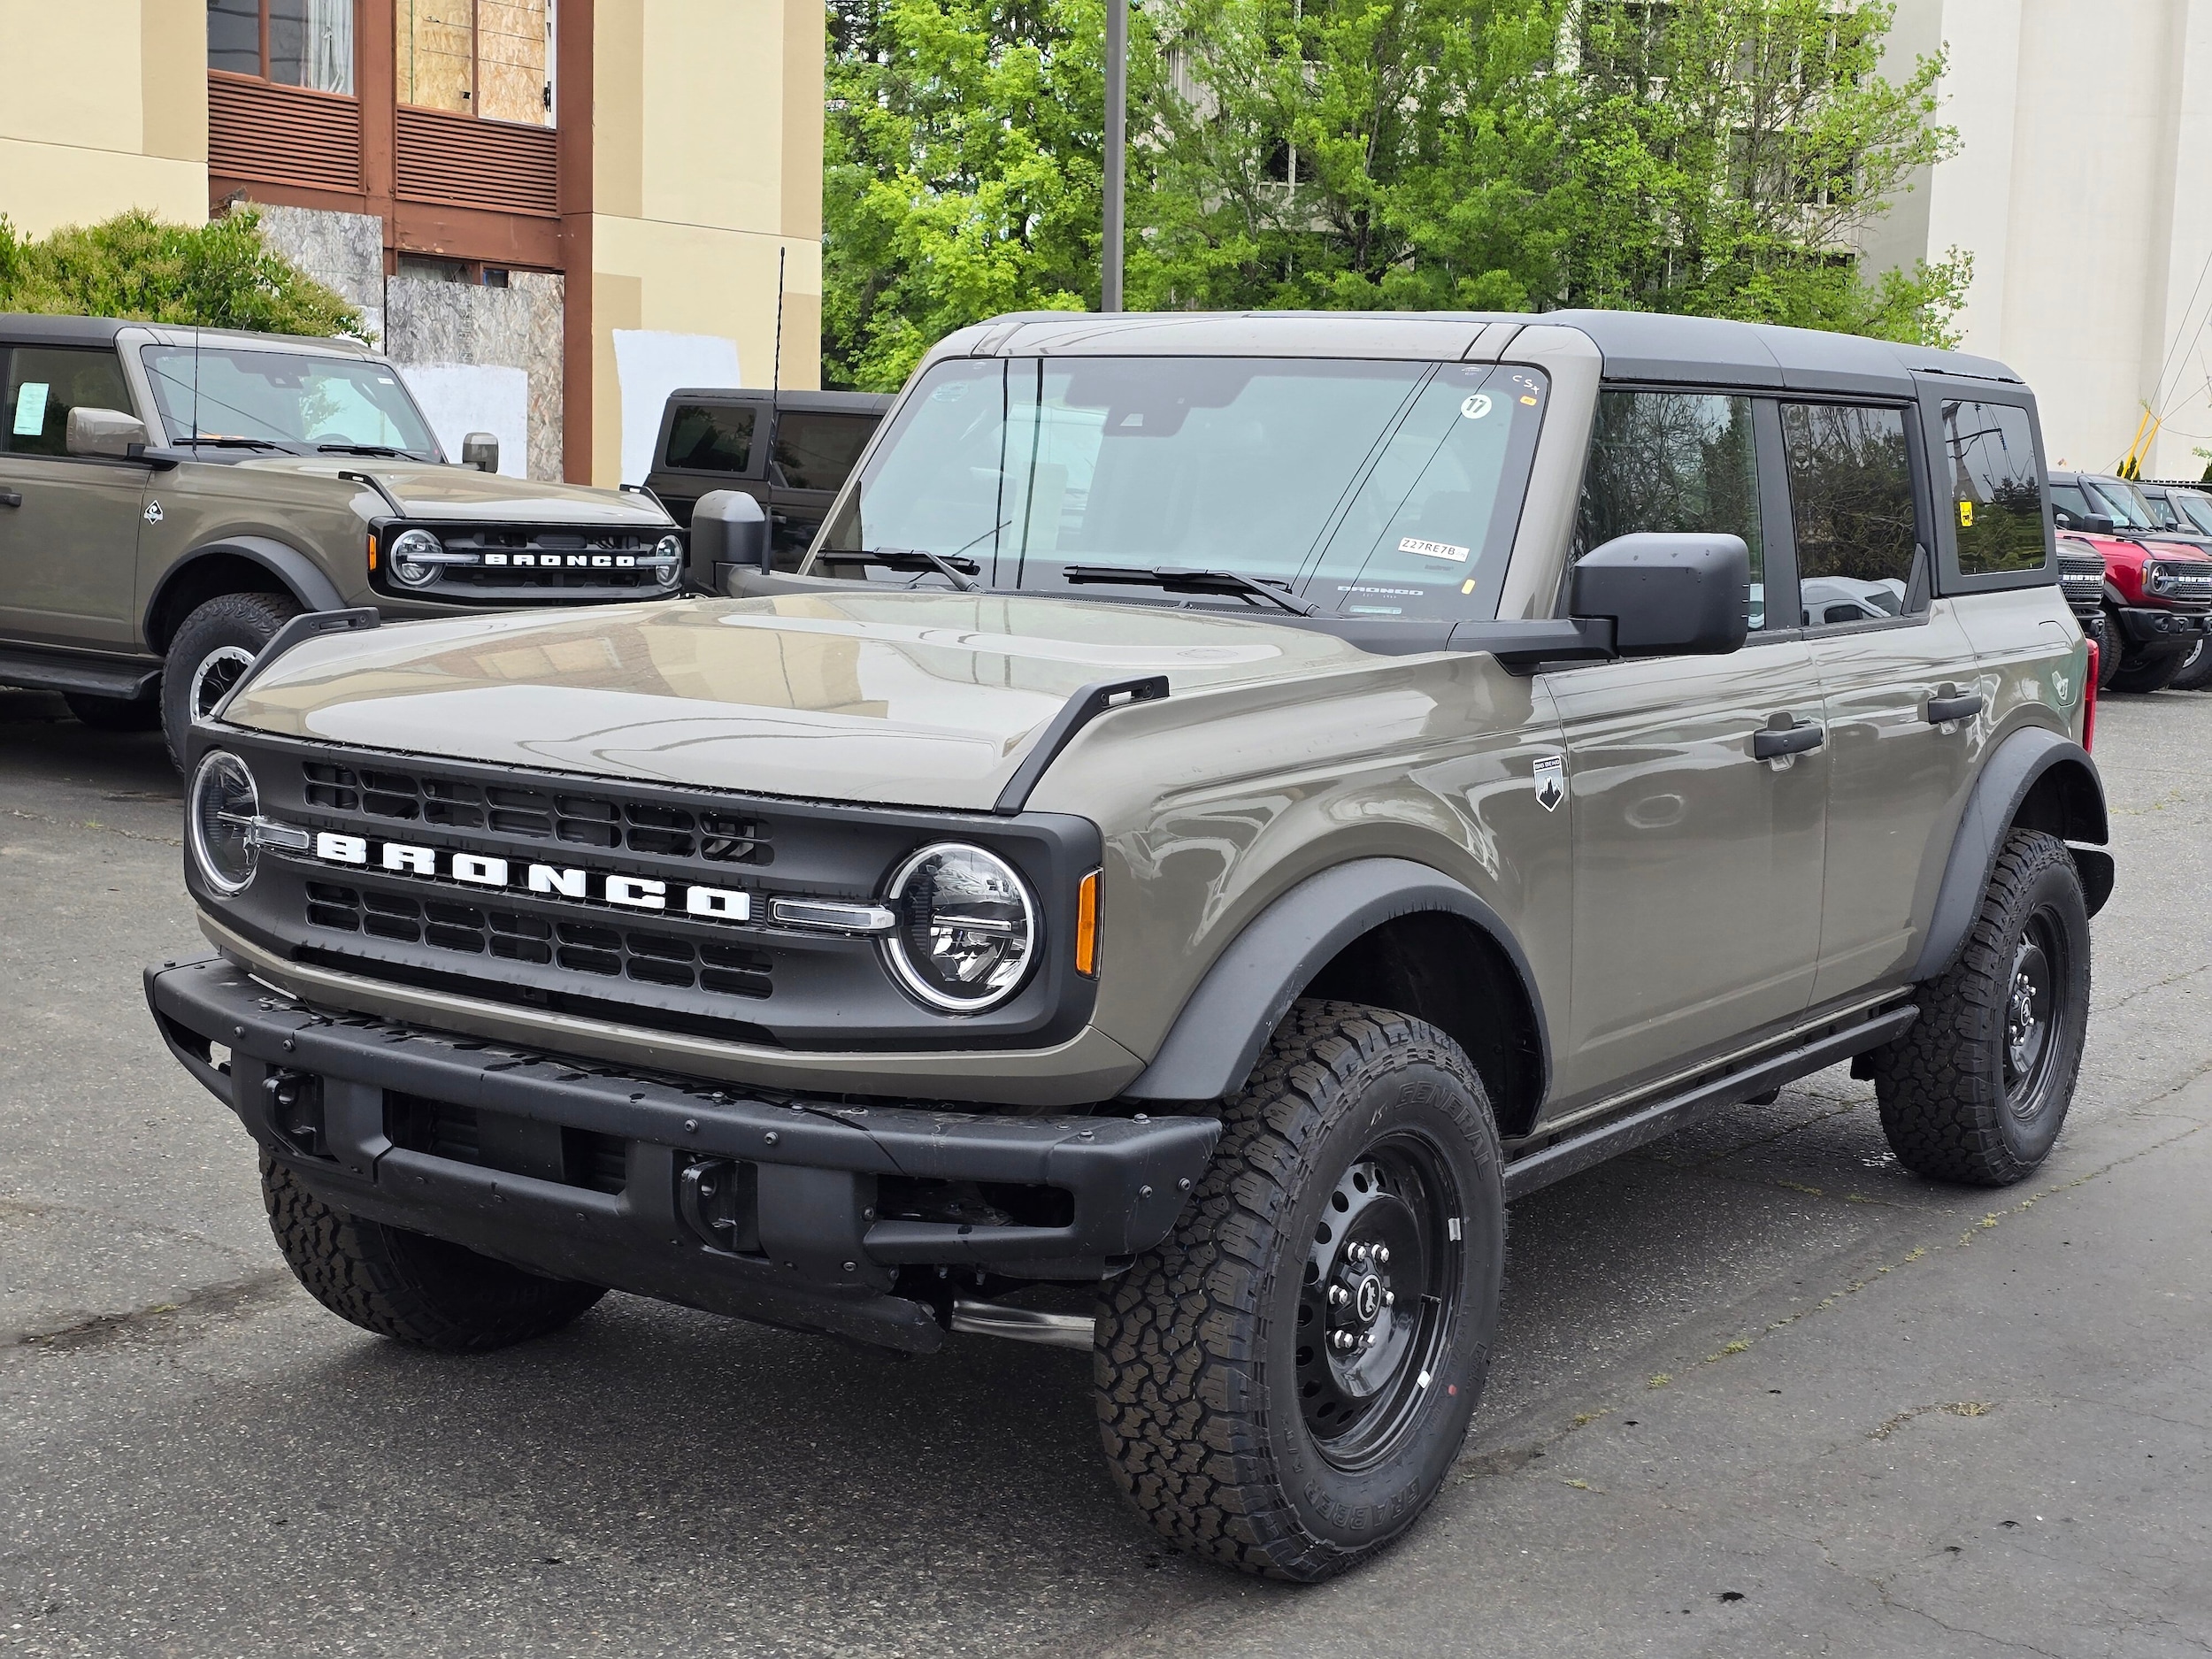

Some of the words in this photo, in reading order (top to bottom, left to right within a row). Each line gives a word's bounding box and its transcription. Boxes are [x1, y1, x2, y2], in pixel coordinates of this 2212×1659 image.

[1466, 397, 1486, 413] 17
[484, 553, 635, 567] BRONCO
[1337, 586, 1424, 595] BRONCO
[317, 832, 750, 921] BRONCO
[1394, 1080, 1491, 1181] GENERAL
[1303, 1476, 1421, 1531] GRABBER
